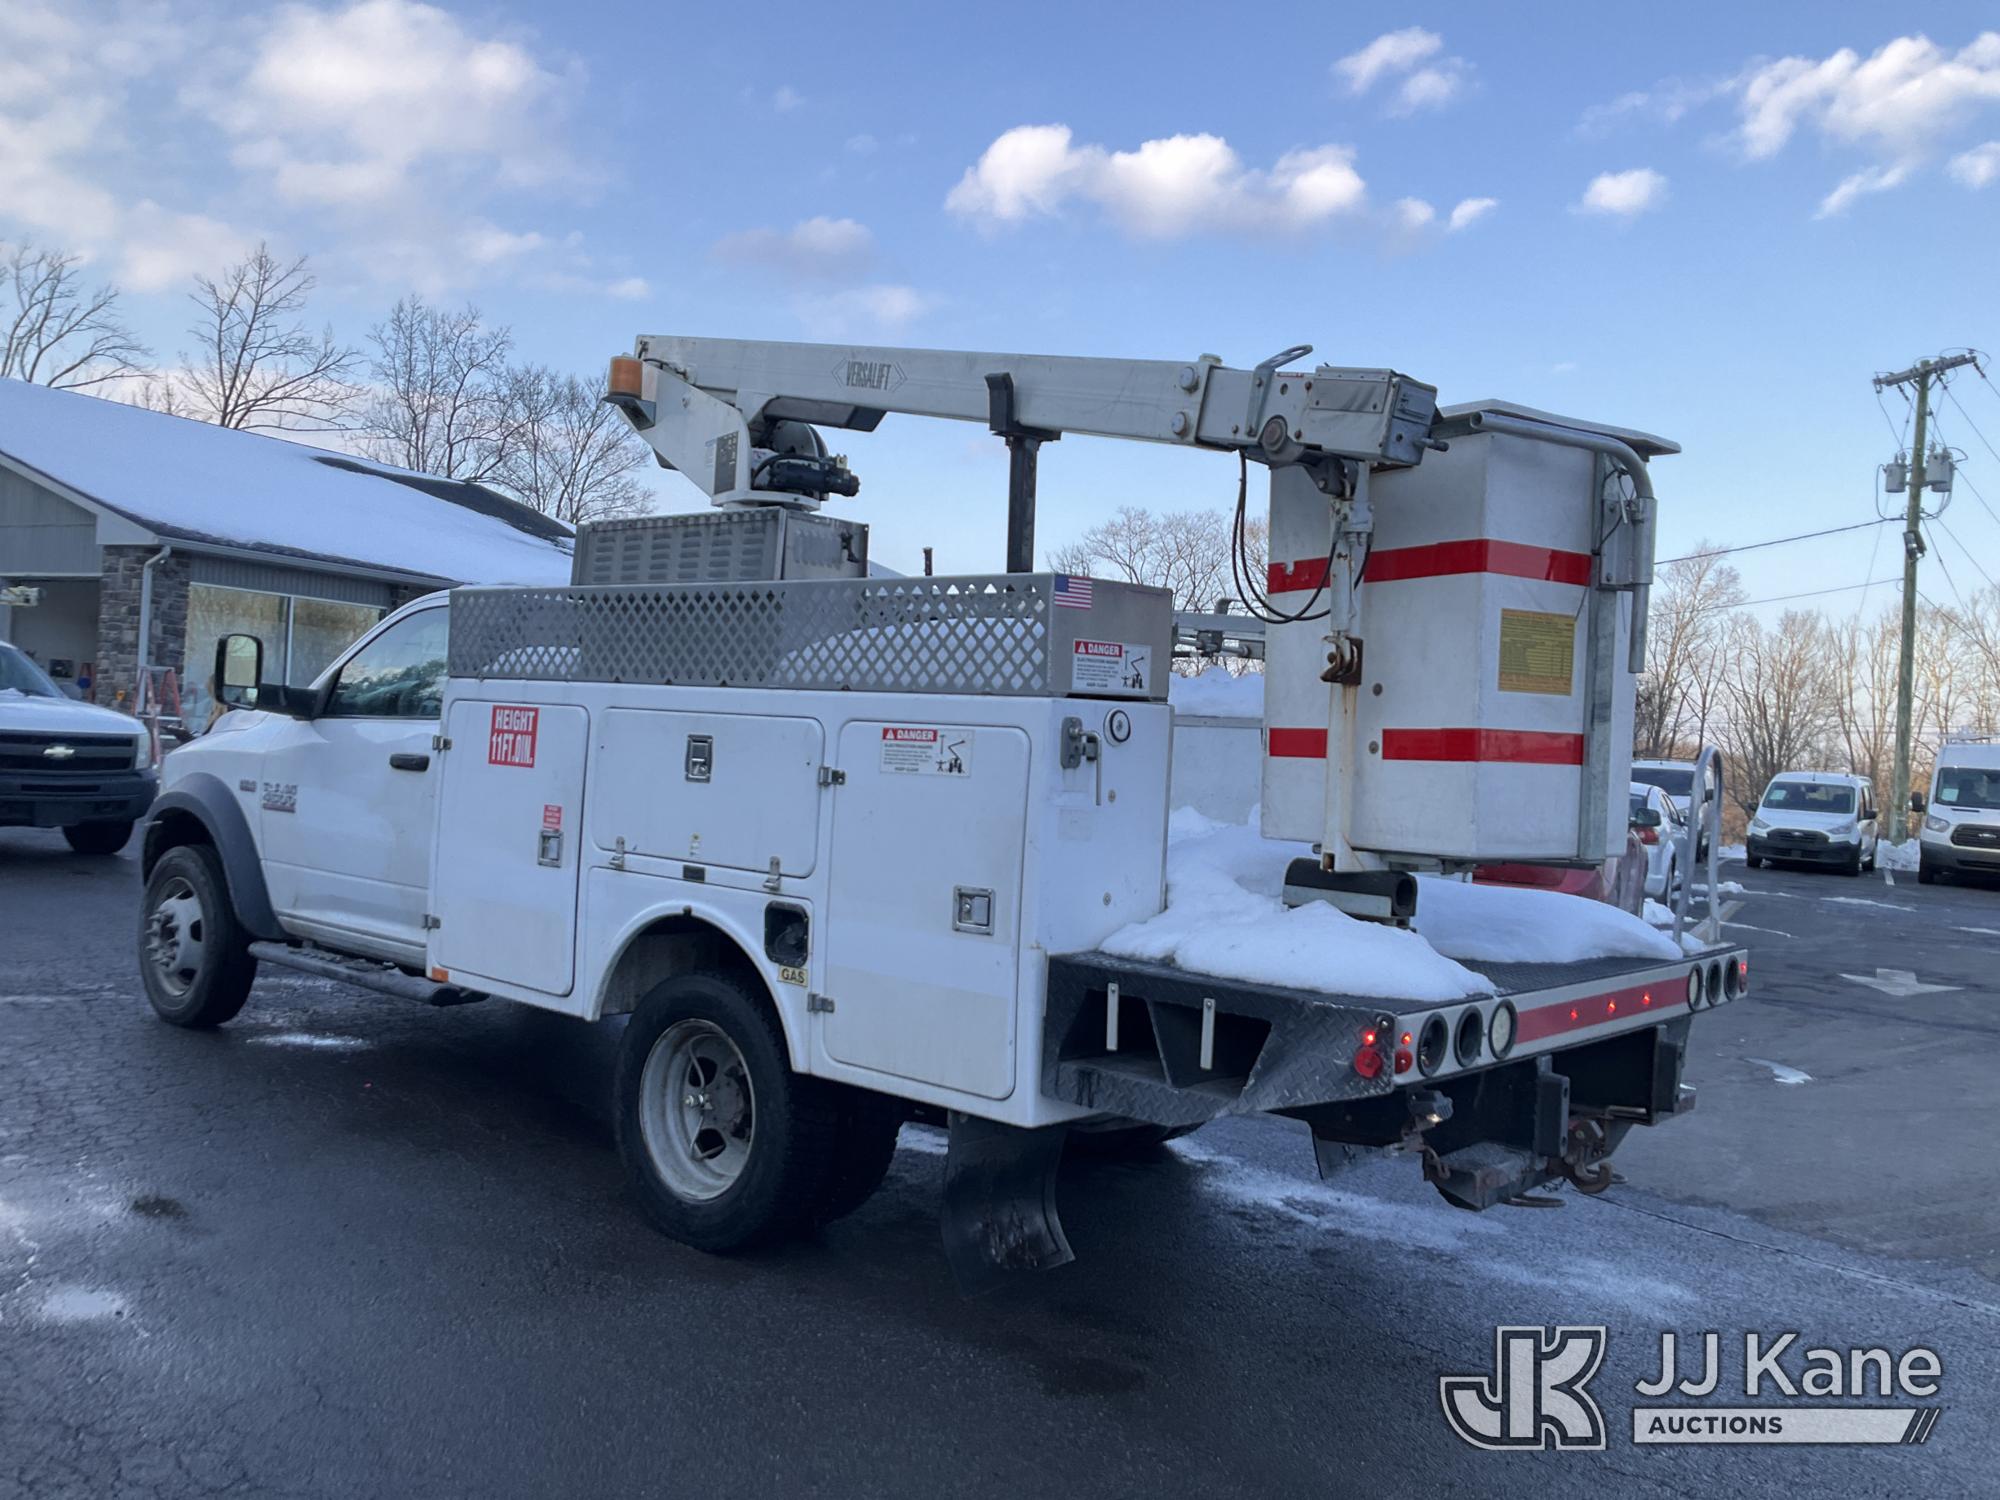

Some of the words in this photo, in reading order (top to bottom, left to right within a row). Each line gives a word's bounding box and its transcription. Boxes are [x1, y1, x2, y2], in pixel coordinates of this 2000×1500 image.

[845, 360, 892, 391] VERSALIFT
[1087, 643, 1121, 656] DANGER
[495, 709, 536, 731] HEIGHT
[896, 729, 935, 741] DANGER
[781, 967, 805, 984] GAS
